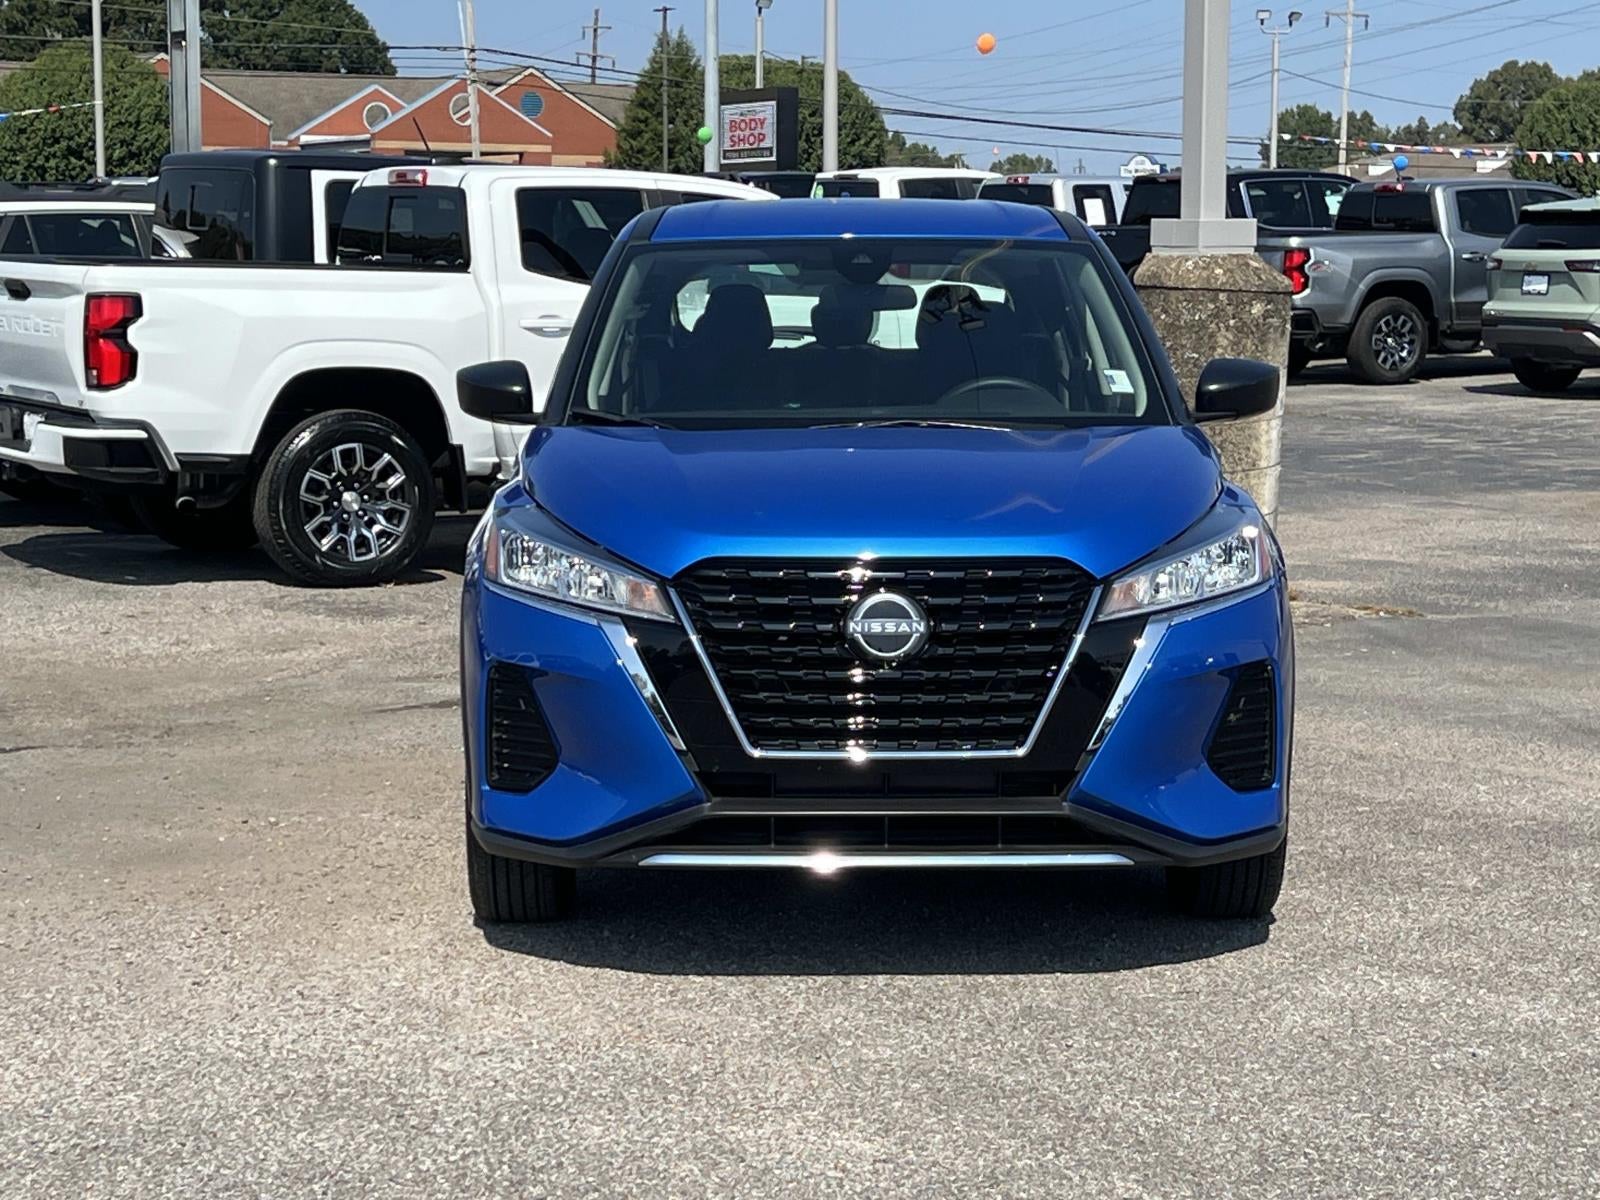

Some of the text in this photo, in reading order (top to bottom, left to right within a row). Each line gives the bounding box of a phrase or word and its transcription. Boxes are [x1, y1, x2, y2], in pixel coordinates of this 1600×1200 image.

[729, 118, 767, 132] BODY
[729, 133, 766, 147] SHOP
[849, 622, 925, 632] NISSAN
